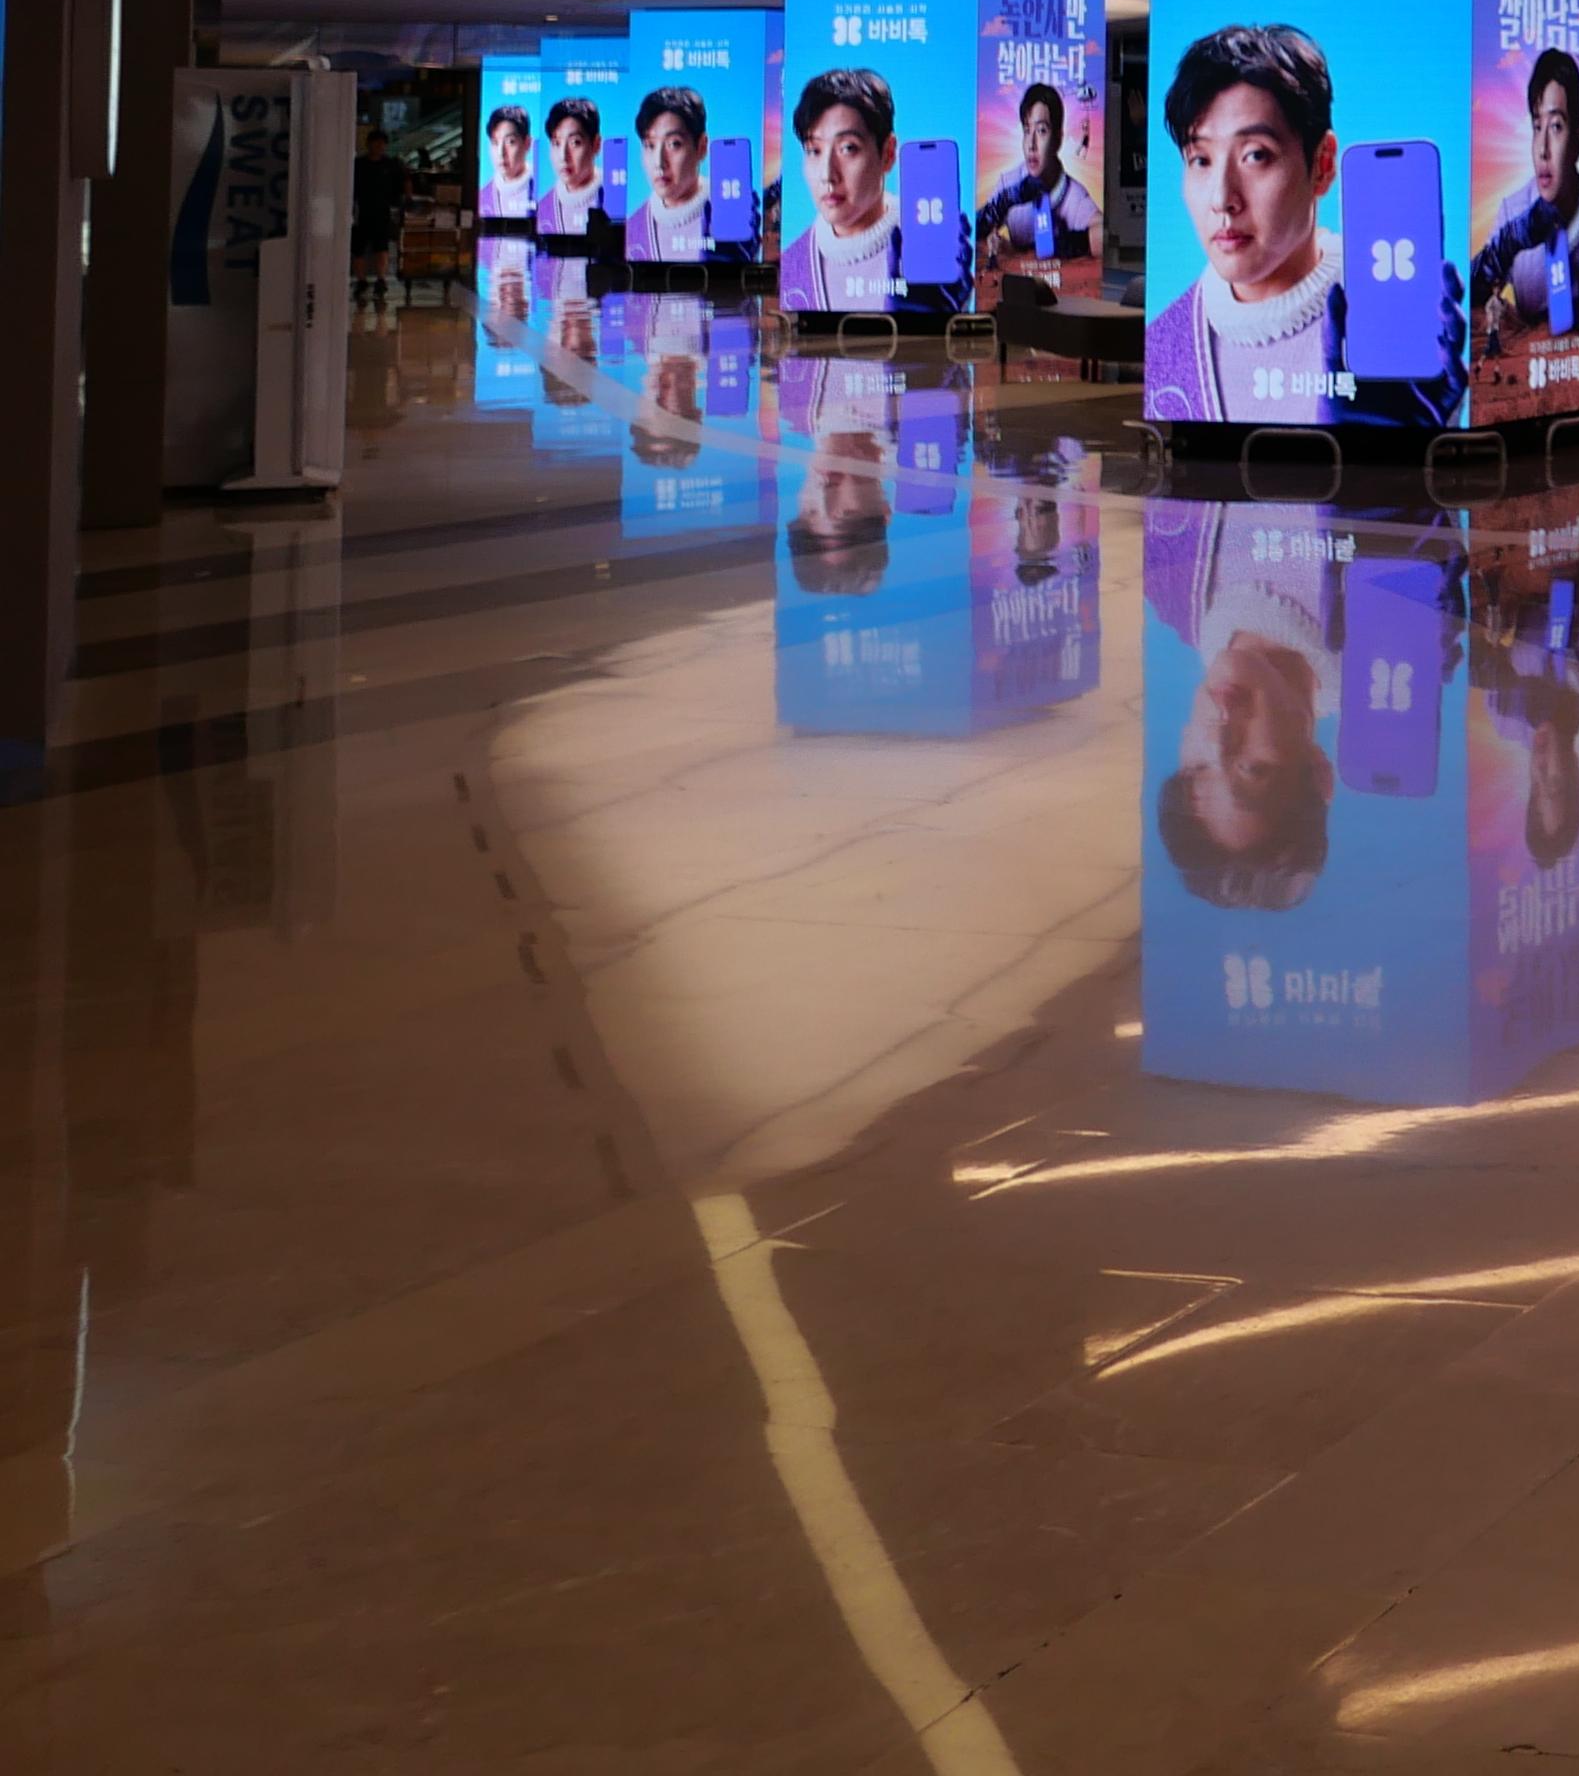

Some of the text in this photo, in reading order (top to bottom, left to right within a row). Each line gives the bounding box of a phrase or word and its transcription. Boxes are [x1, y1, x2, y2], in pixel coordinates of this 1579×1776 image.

[868, 17, 928, 44] 바비톡
[688, 48, 729, 70] 바비톡
[997, 40, 1087, 86] 살아남는다
[223, 93, 269, 277] SWEAT
[1290, 371, 1357, 401] 바비톡
